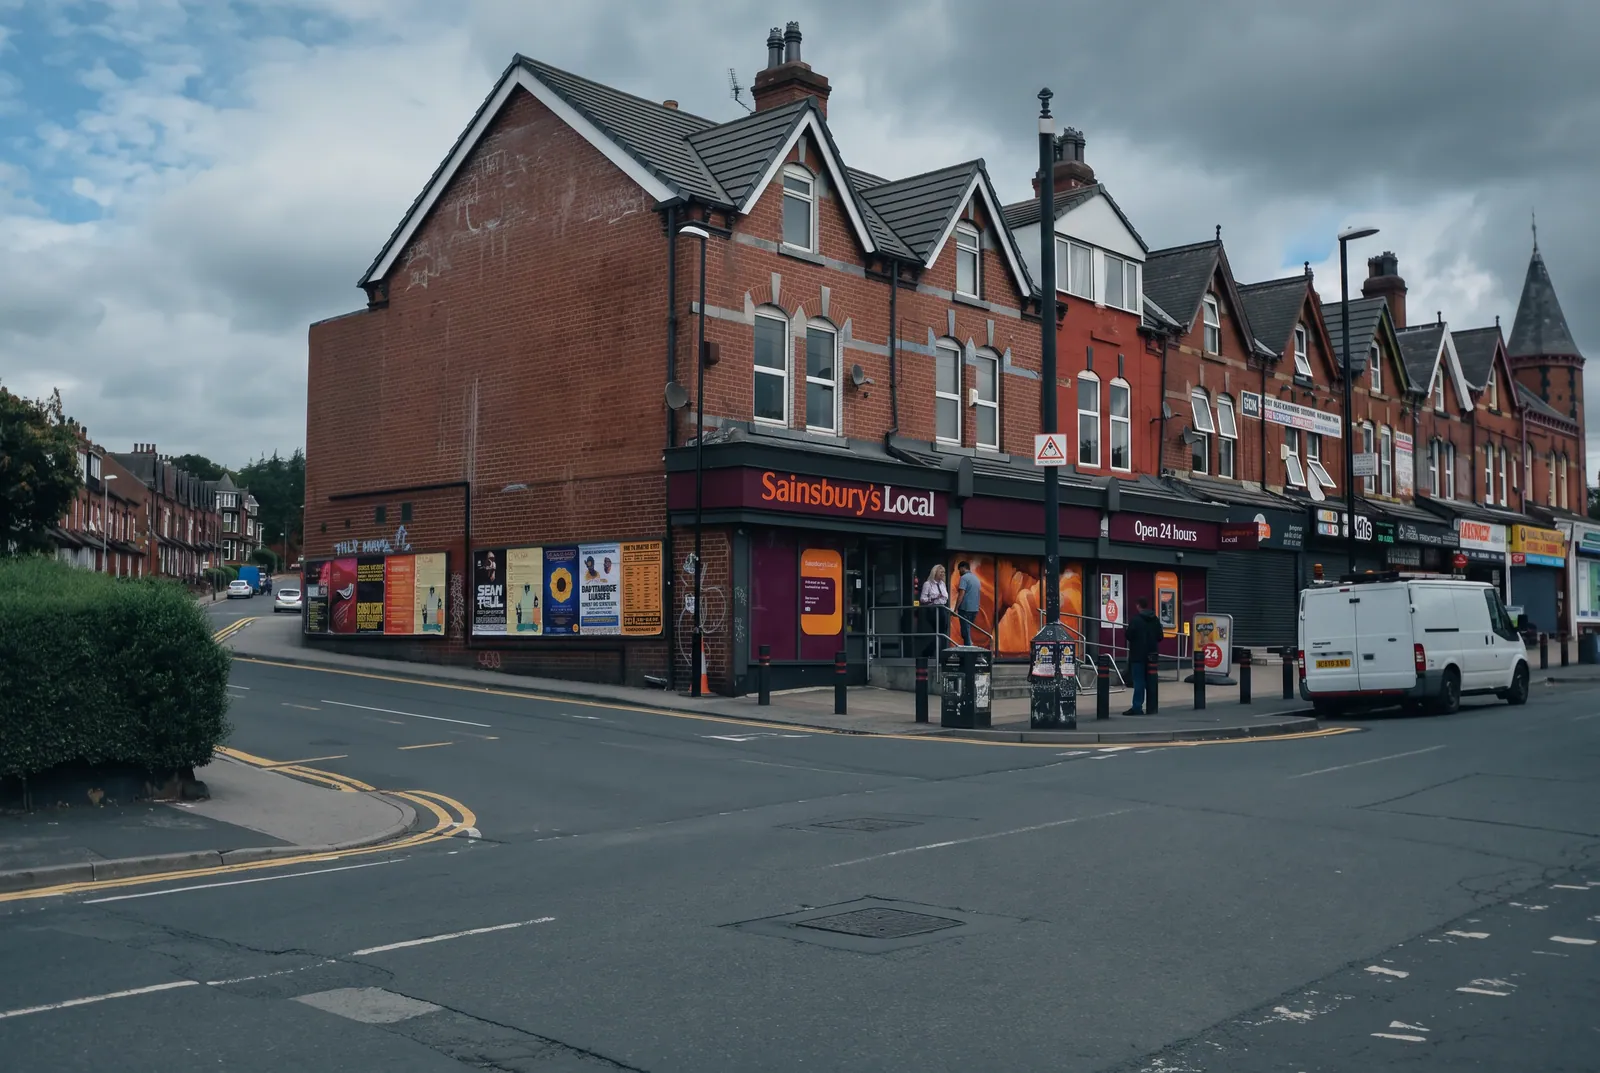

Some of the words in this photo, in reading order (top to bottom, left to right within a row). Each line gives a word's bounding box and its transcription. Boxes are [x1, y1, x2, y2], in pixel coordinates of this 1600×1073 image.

[762, 472, 881, 516] Sainsbury's
[884, 485, 935, 517] Local
[1135, 520, 1158, 541] Open
[1160, 522, 1171, 539] 24
[1173, 524, 1197, 541] hours
[477, 584, 503, 597] SEAN
[1204, 649, 1218, 659] 24
